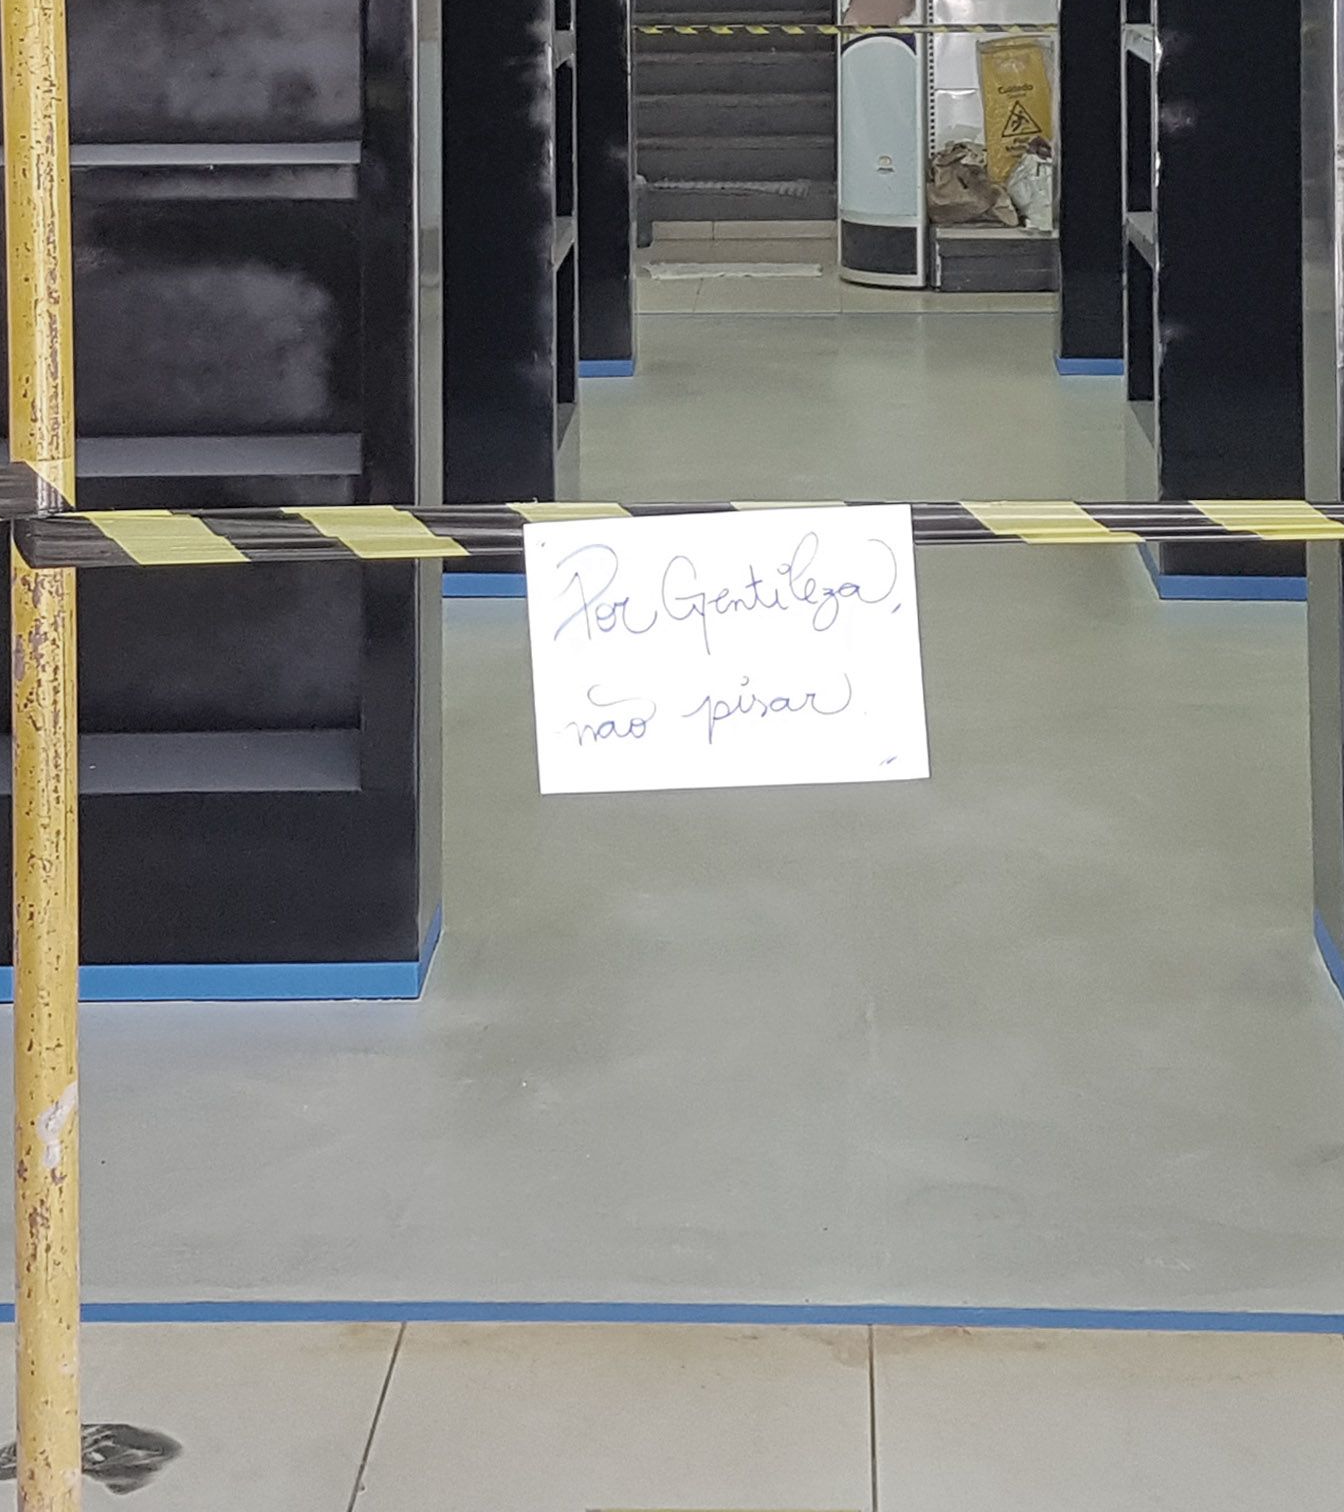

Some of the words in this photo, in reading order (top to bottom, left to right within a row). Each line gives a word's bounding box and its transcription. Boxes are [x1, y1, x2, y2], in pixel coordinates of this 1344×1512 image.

[554, 544, 657, 641] Por
[565, 684, 657, 746] não
[681, 673, 852, 745] pisar
